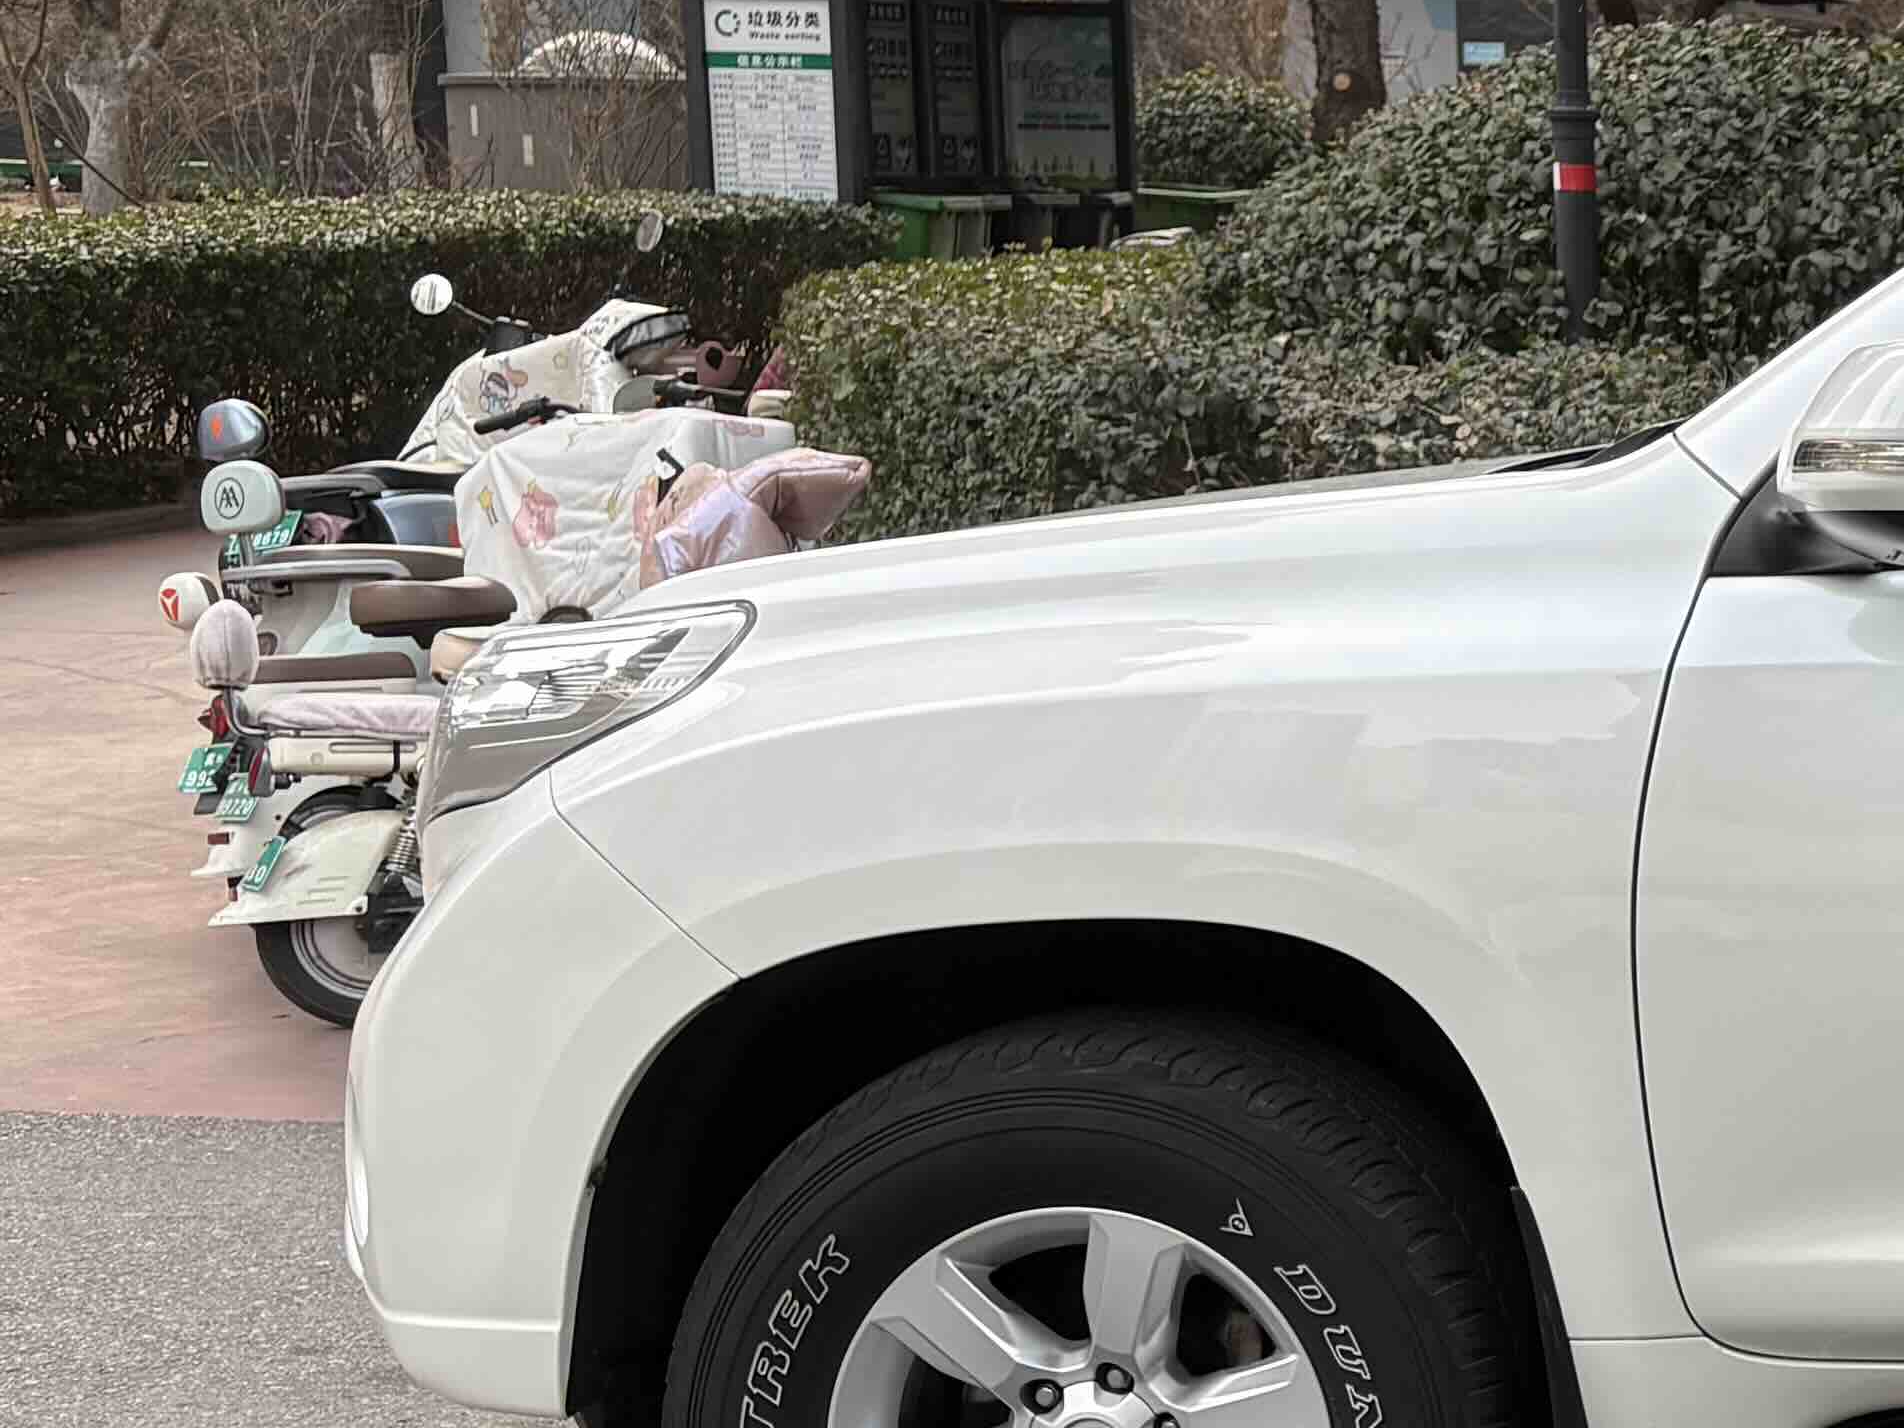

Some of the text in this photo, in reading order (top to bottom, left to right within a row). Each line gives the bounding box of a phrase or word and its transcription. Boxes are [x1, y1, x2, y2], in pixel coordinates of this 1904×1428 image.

[747, 10, 820, 28] 垃圾分类
[749, 31, 821, 42] Waste sorting
